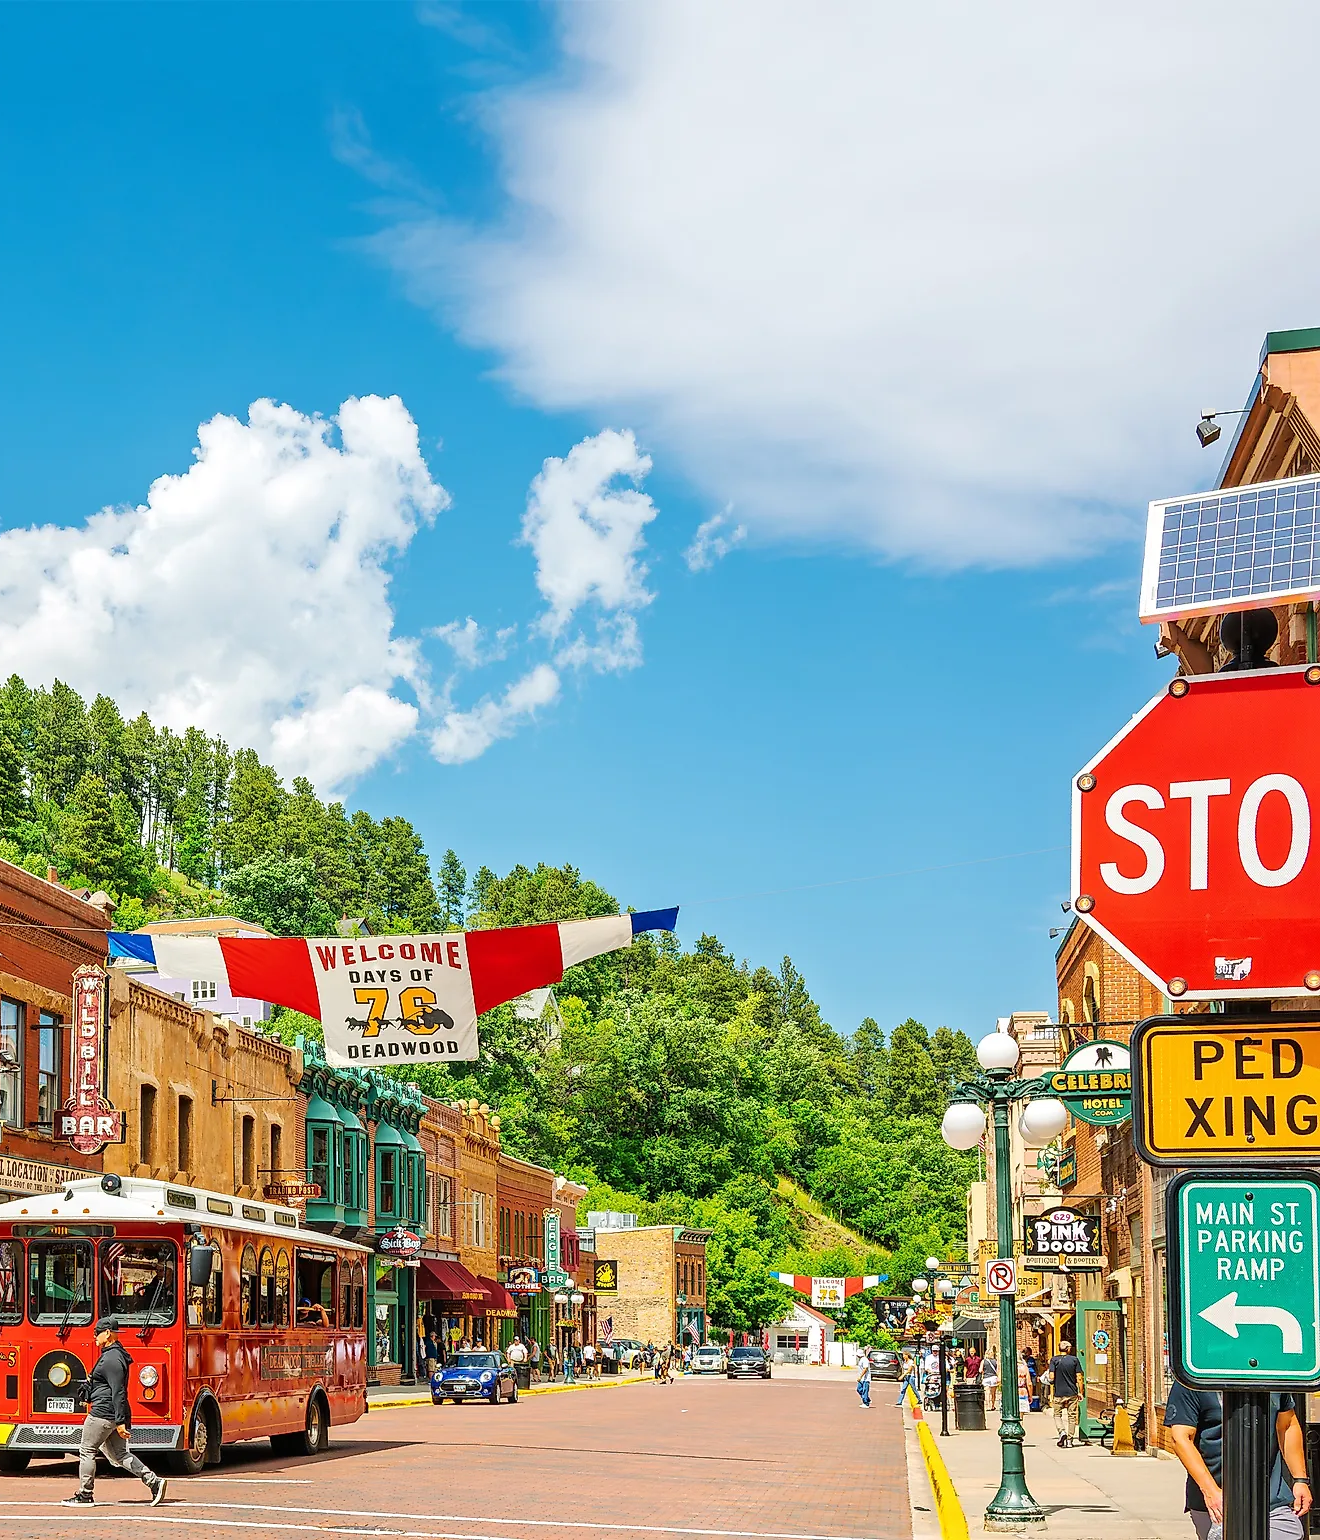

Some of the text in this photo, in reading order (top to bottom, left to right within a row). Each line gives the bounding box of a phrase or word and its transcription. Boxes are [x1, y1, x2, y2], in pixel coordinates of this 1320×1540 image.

[1099, 772, 1312, 896] STO
[315, 941, 462, 972] WELCOME
[349, 969, 433, 984] DAYS OF
[353, 986, 440, 1038] 76
[80, 977, 97, 1106] WILD BILL
[347, 1041, 459, 1059] DEADWOOD
[1193, 1038, 1304, 1081] PED
[1051, 1073, 1131, 1091] CELEBRI
[1083, 1098, 1124, 1110] HOTEL
[61, 1116, 115, 1136] BAR
[1184, 1095, 1318, 1138] XING
[7, 1160, 50, 1183] LOCATION
[298, 1187, 315, 1195] POST
[1196, 1202, 1302, 1225] MAIN ST.
[1035, 1221, 1090, 1241] PINK
[380, 1237, 421, 1250] Sick Boy
[548, 1222, 557, 1271] EAGLE
[1037, 1241, 1090, 1253] DOOR
[1198, 1230, 1304, 1254] PARKING
[1217, 1257, 1285, 1281] RAMP
[541, 1275, 564, 1284] BAR
[1097, 1313, 1111, 1321] 625
[7, 1352, 16, 1368] 5
